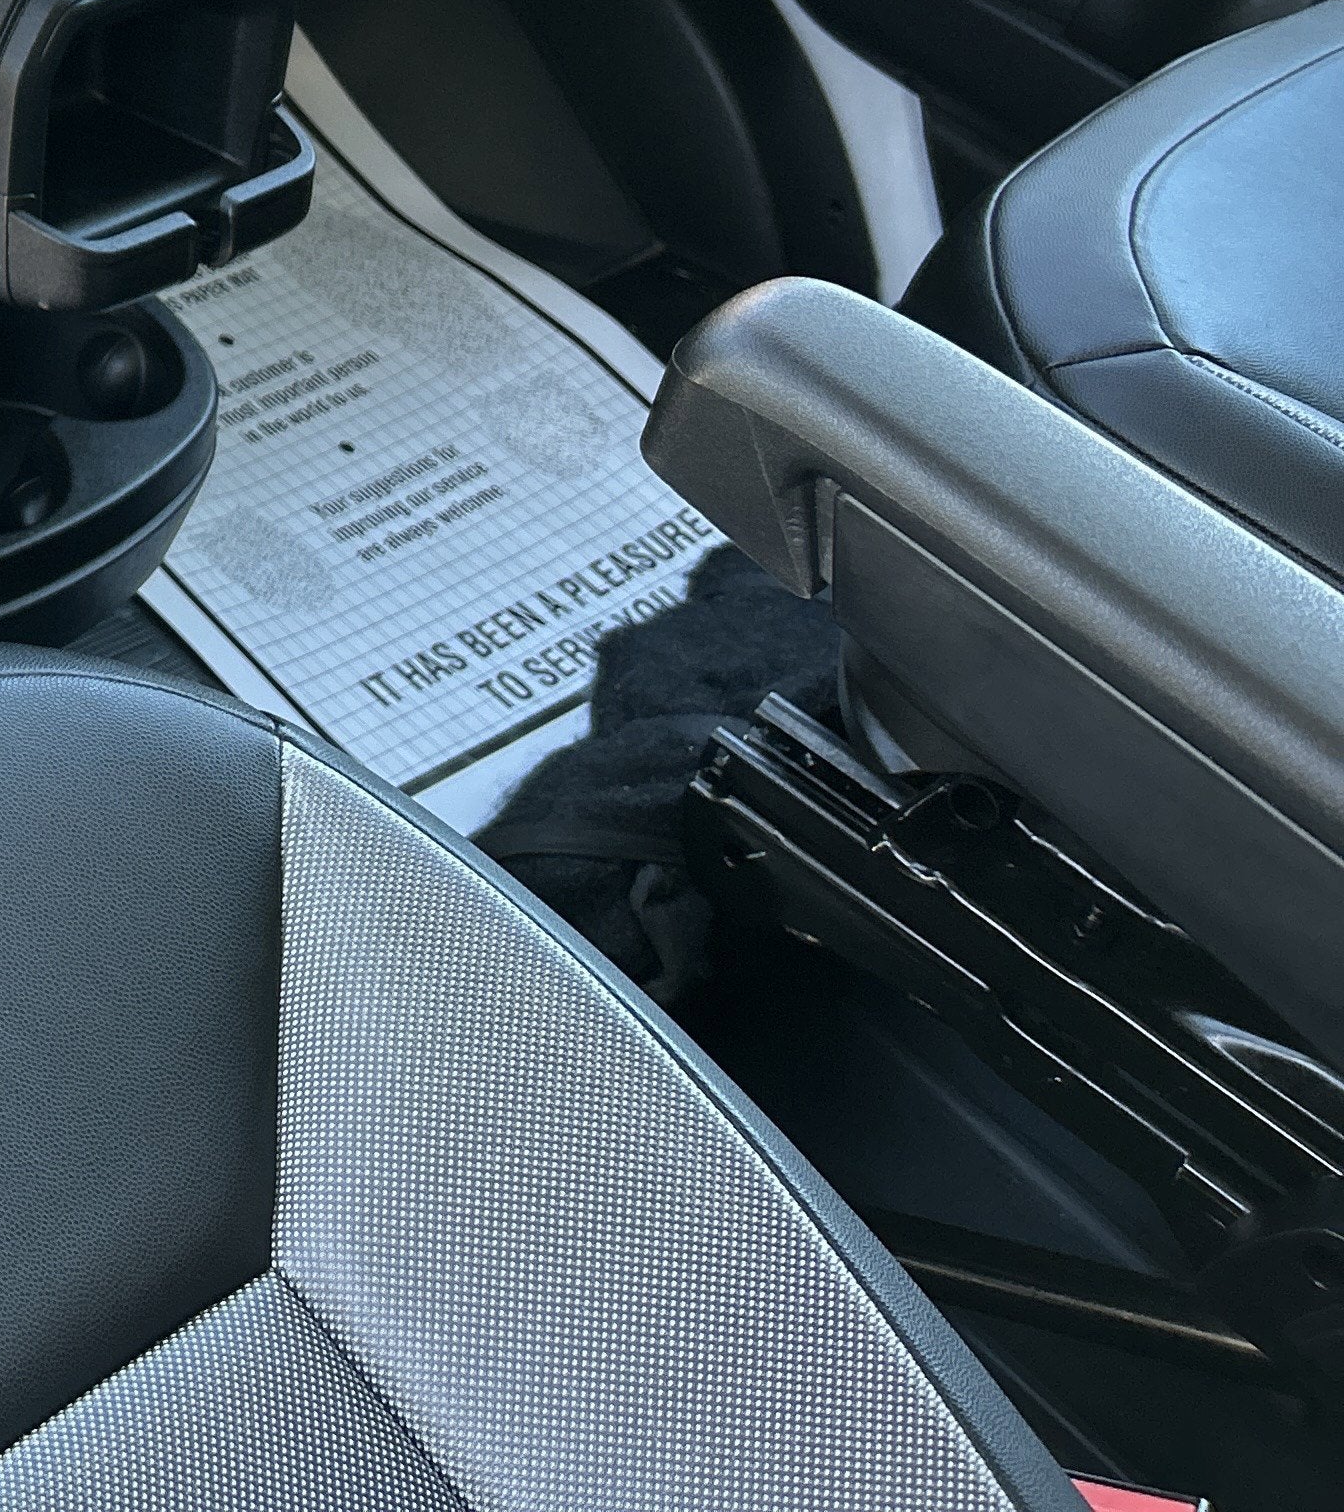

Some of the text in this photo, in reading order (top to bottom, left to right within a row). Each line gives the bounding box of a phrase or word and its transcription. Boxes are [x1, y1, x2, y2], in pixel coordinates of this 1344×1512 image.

[219, 349, 380, 428] most important person
[230, 356, 297, 393] customer
[293, 349, 315, 367] is
[258, 417, 290, 439] the
[288, 394, 332, 426] world
[326, 391, 346, 409] to
[310, 443, 460, 519] Your suggestions for
[330, 460, 489, 543] improving our service
[357, 542, 387, 563] are
[383, 517, 439, 551] always
[361, 506, 714, 709] IT HAS BEEN A PLEASURE
[475, 669, 534, 710] TO
